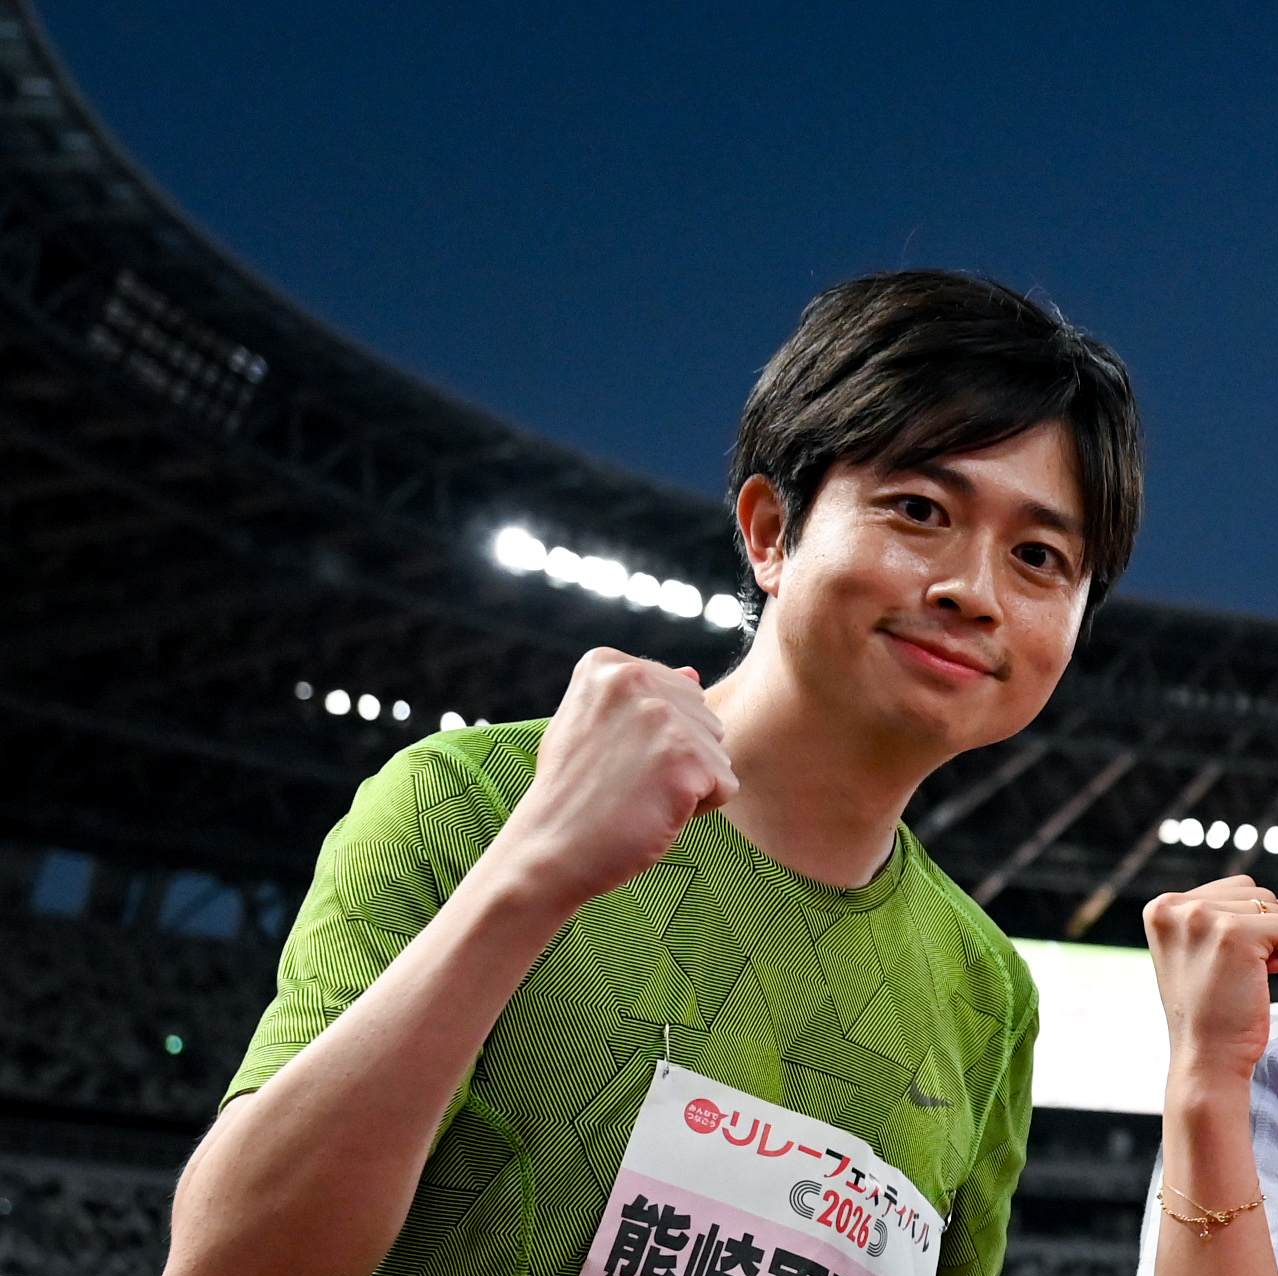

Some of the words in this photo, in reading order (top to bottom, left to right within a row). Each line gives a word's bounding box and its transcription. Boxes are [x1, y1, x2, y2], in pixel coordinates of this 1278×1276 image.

[722, 1110, 930, 1253] リレーフェスティバル
[819, 1190, 869, 1250] 2026
